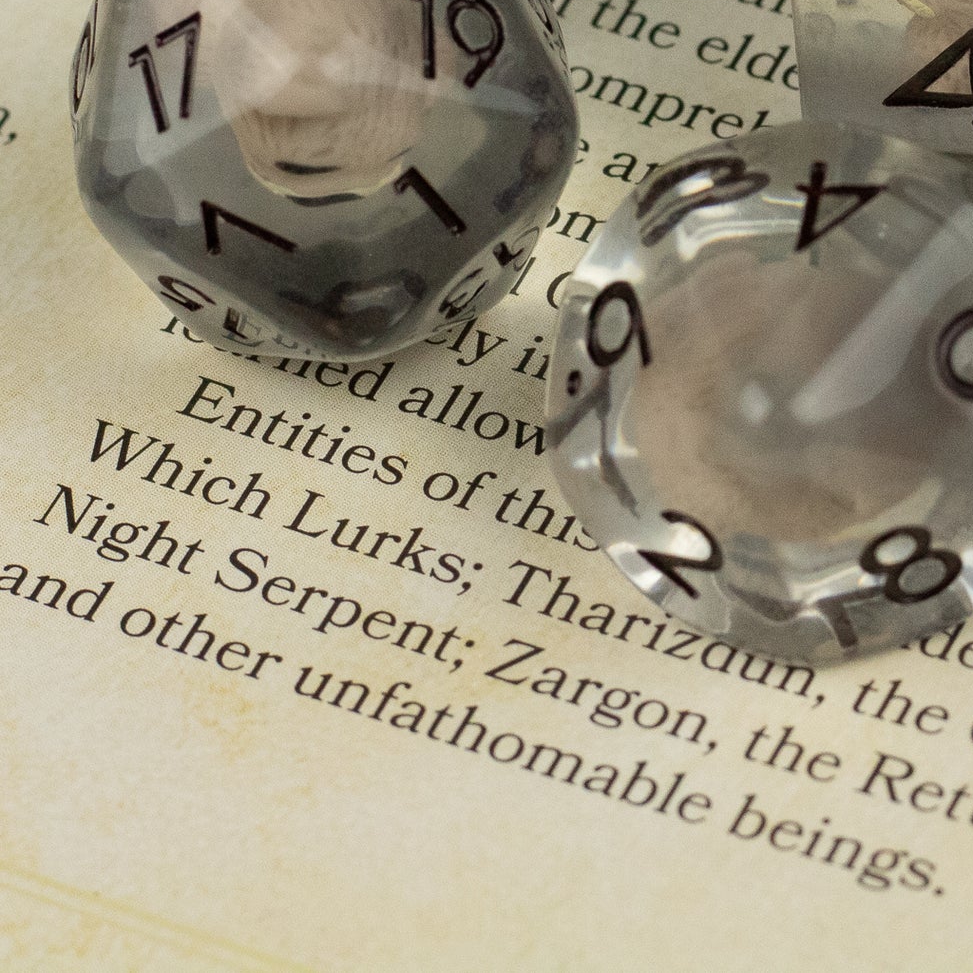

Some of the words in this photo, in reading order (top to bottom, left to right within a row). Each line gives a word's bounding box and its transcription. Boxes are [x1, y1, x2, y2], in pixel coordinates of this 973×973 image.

[128, 12, 200, 134] 17
[590, 0, 682, 49] the
[697, 35, 800, 92] elde
[175, 375, 410, 487] Entities
[420, 470, 500, 512] of
[500, 489, 605, 555] this
[398, 384, 550, 457] allow
[83, 417, 272, 522] Which
[282, 489, 485, 599] Lurks;
[502, 559, 828, 707] Tharizdun,
[850, 677, 950, 737] the
[637, 509, 722, 600] 2
[858, 525, 962, 605] 8
[32, 482, 208, 577] Night
[214, 547, 478, 672] Serpent;
[484, 637, 720, 755] Zargon,
[742, 722, 843, 784] the
[0, 562, 115, 625] and
[120, 607, 285, 682] other
[293, 664, 710, 827] unfathomable
[728, 792, 948, 897] beings.
